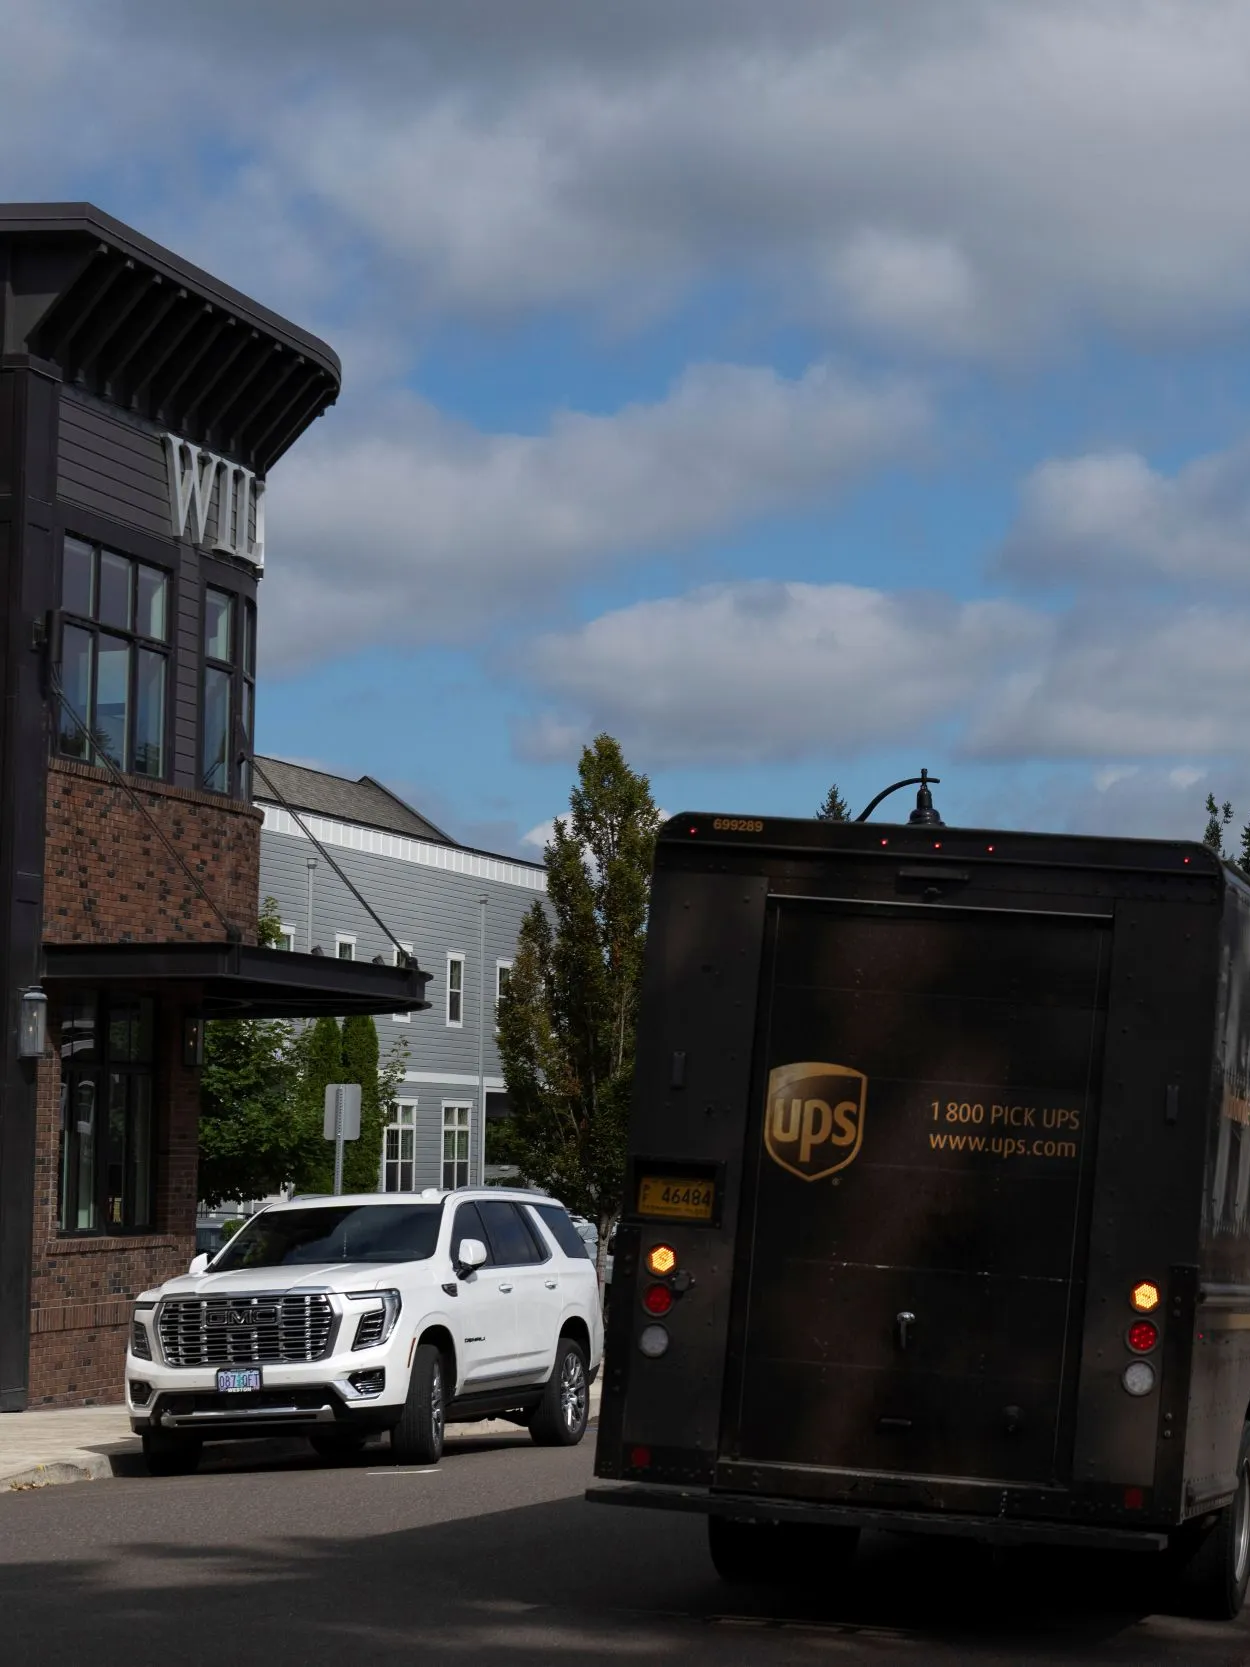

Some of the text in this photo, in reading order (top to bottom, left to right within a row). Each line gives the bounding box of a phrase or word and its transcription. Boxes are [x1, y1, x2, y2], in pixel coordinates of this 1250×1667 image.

[712, 817, 764, 832] 699289
[931, 1101, 1081, 1131] 1 800 PICK UPS
[773, 1097, 858, 1162] ups
[929, 1133, 1077, 1159] www.ups.com
[661, 1186, 711, 1207] 46484
[205, 1308, 276, 1326] GMC
